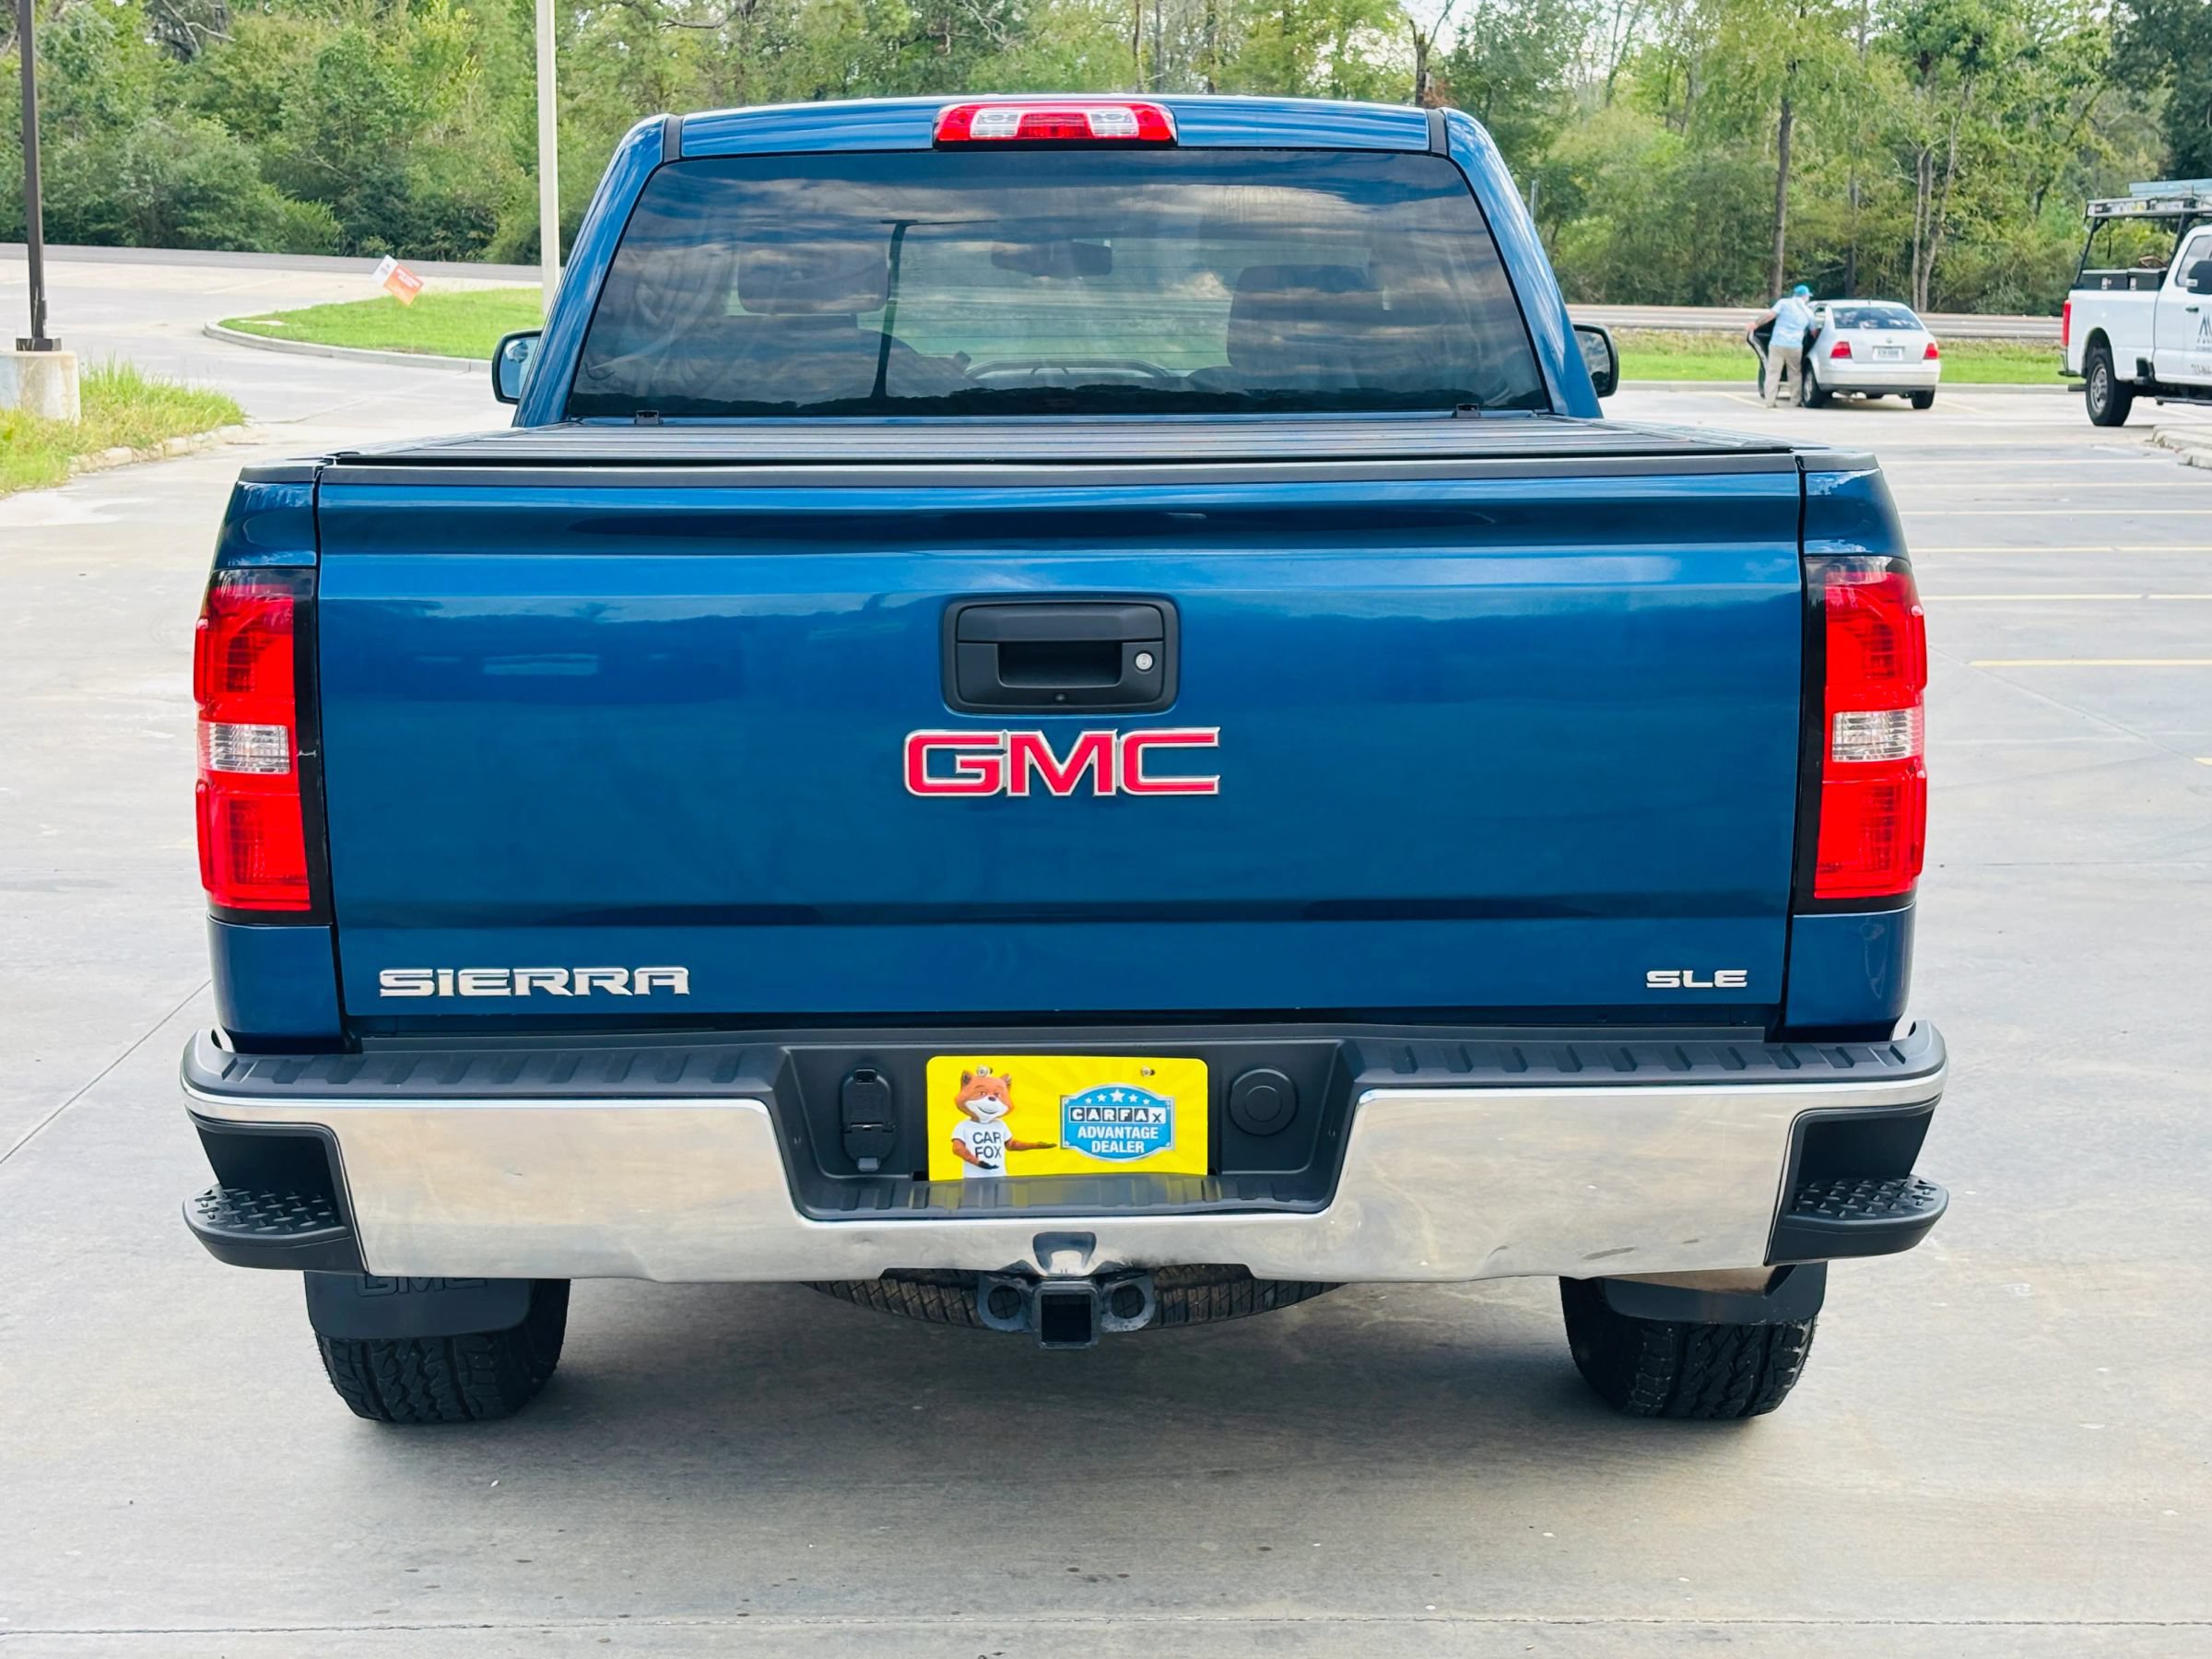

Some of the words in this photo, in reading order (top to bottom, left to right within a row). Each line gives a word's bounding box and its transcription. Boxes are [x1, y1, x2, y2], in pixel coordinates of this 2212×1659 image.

[903, 727, 1220, 796] GMC
[379, 966, 690, 997] SIERRA
[1646, 970, 1748, 988] SLE
[972, 1131, 1002, 1144] CAR
[1077, 1125, 1159, 1139] ADVANTAGE
[974, 1145, 1002, 1159] FOX
[1091, 1140, 1145, 1154] DEALER
